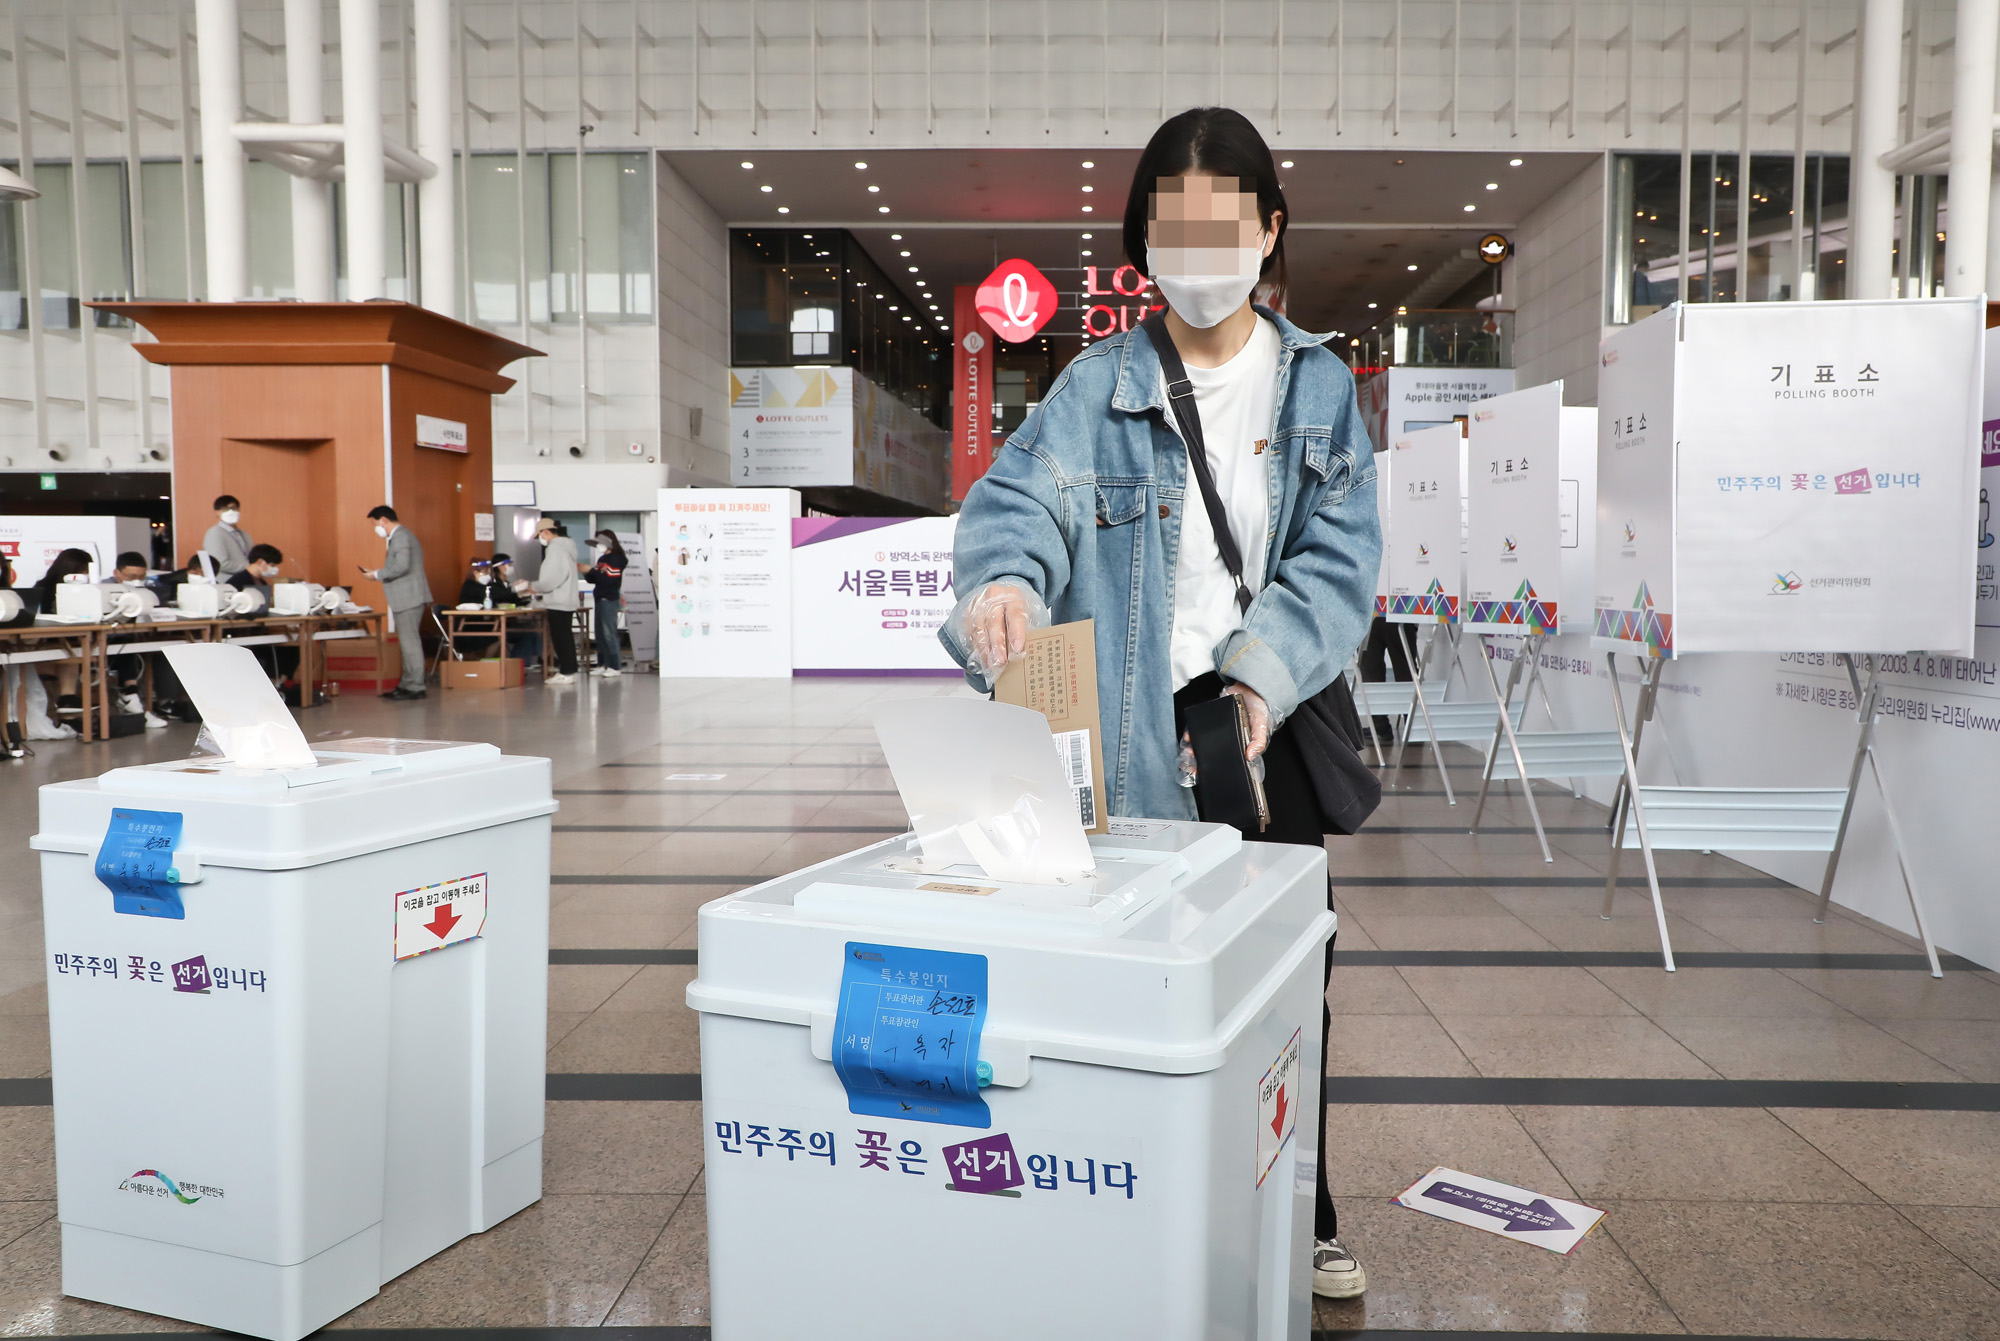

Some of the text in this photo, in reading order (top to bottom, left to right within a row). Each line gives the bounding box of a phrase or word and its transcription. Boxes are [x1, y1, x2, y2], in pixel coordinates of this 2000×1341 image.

[1084, 304, 1164, 337] OU
[1405, 392, 1433, 403] Apple
[1434, 392, 1452, 403] 공인
[1453, 392, 1478, 402] 서비스
[1774, 388, 1875, 400] POLLING BOOTH
[967, 357, 978, 456] LOTTE OUTLETS
[742, 429, 750, 440] 4
[743, 447, 750, 459] 3
[743, 466, 750, 477] 2
[1717, 475, 1782, 492] 민주주의
[1790, 473, 1828, 491] 꽃은
[890, 551, 931, 563] 방역소독
[1809, 576, 1871, 588] 선거관리위원회
[1913, 660, 1924, 675] 4.
[1926, 661, 1938, 678] 8.
[1956, 660, 1998, 686] 태어난
[1785, 682, 1809, 703] 자세한
[1811, 684, 1837, 707] 사항은
[403, 882, 481, 911] 이곳을 잡고 이동해 주세요
[53, 952, 119, 980] 민주주의
[127, 954, 165, 983] 꽃은
[880, 968, 948, 988] 특수봉인지
[884, 992, 924, 1006] 투표관리관
[880, 1015, 919, 1029] 투표참관인
[714, 1120, 837, 1166] 민주주의
[855, 1127, 928, 1176] 꽃은
[130, 1182, 155, 1196] 아름다운
[156, 1187, 169, 1198] 선거
[199, 1185, 225, 1199] 대한민국
